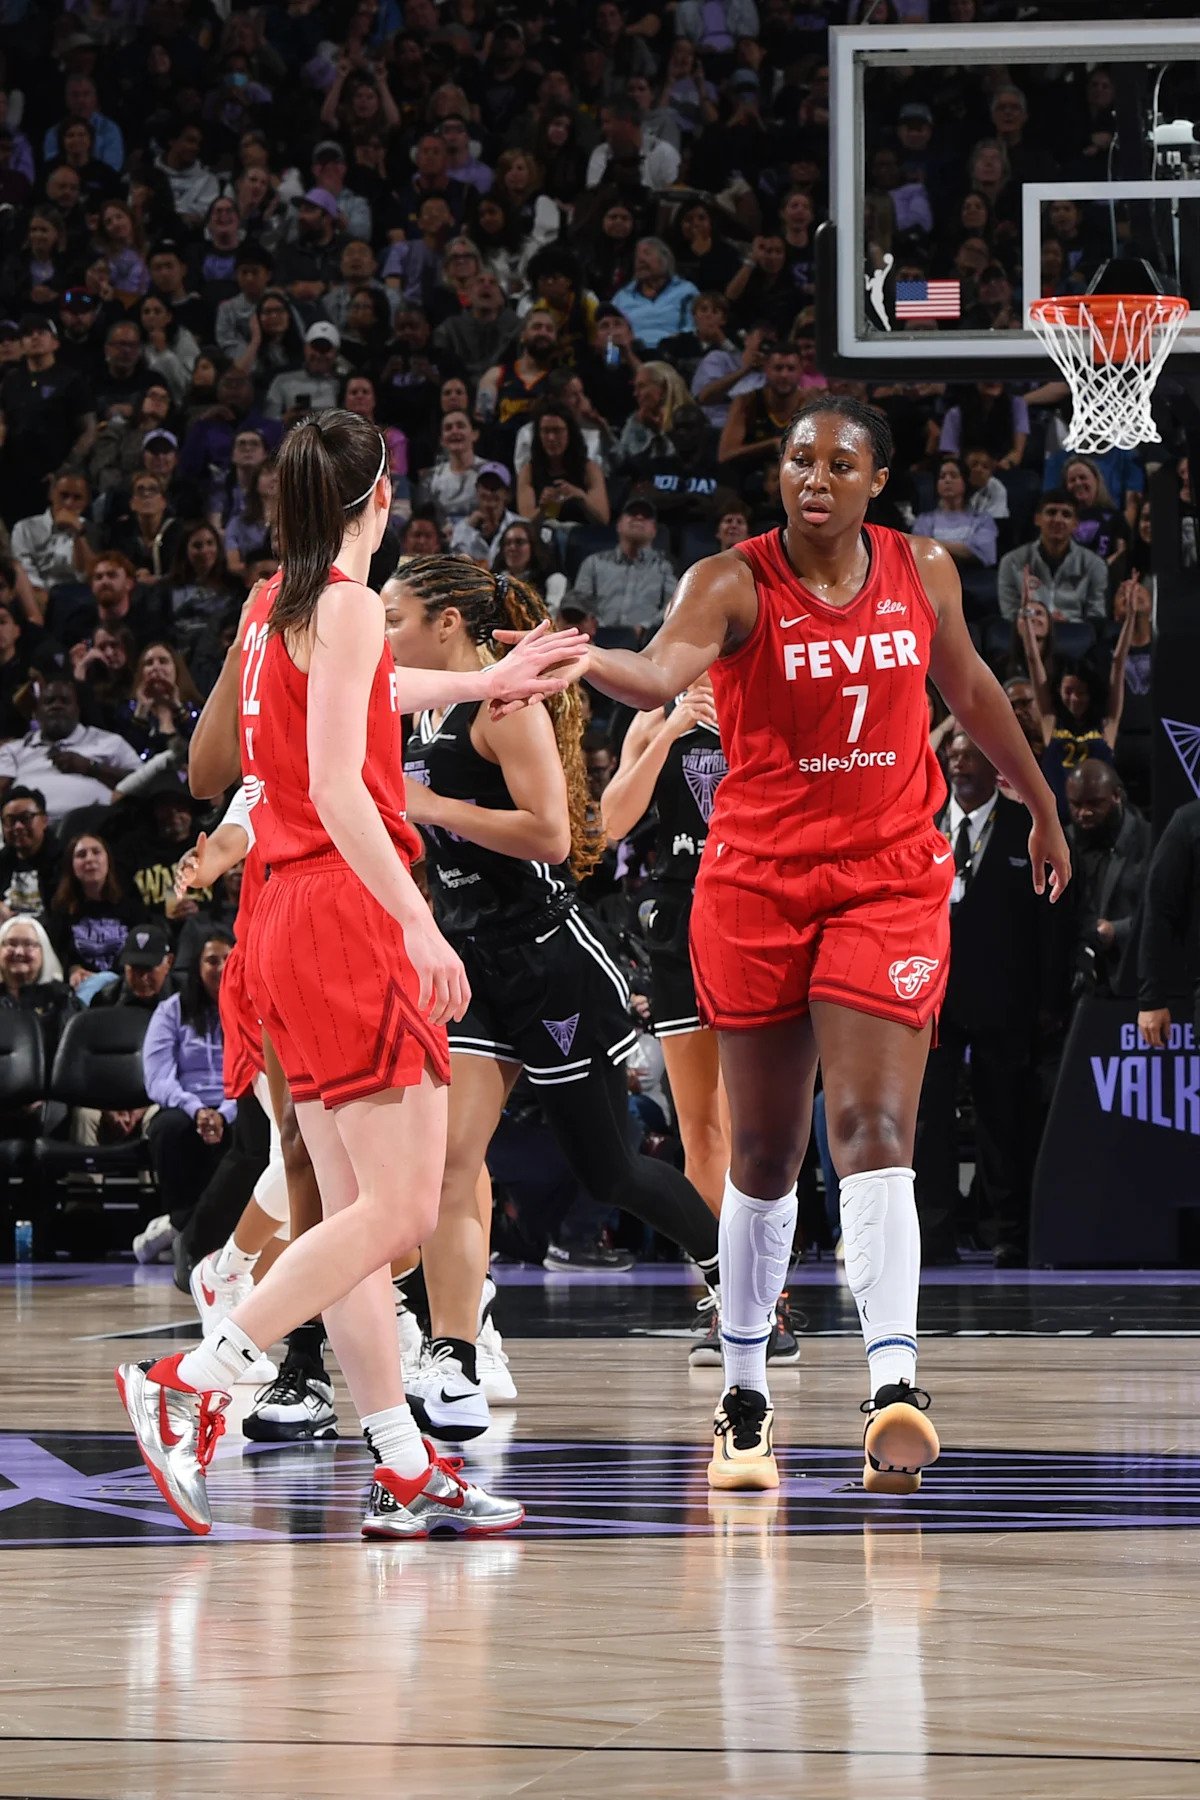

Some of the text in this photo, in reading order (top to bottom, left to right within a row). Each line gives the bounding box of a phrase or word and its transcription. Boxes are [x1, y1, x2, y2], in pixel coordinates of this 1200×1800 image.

[876, 599, 907, 615] Lilly
[783, 629, 921, 681] FEVER
[842, 685, 869, 743] 7
[799, 748, 896, 774] salesforce
